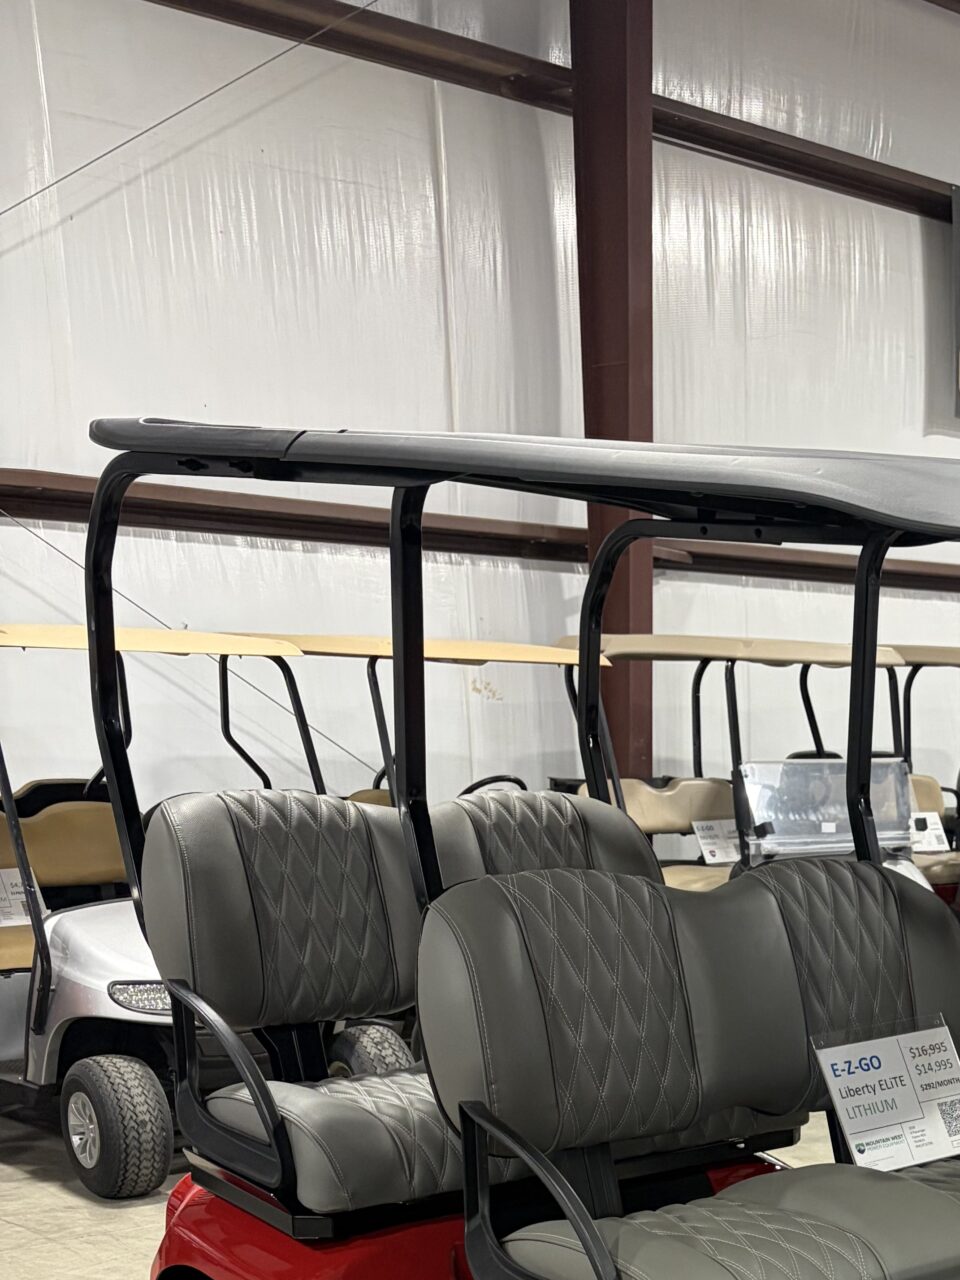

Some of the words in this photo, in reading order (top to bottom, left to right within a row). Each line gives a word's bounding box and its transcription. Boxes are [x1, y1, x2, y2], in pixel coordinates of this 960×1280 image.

[909, 1041, 948, 1060] $16,995
[830, 1055, 882, 1078] E-Z-GO
[914, 1058, 953, 1076] $14,995
[838, 1082, 877, 1100] Liberty
[920, 1077, 960, 1092] $292/MONTH
[845, 1097, 898, 1120] LITHIUM
[865, 1138, 891, 1146] MOUNTAIN
